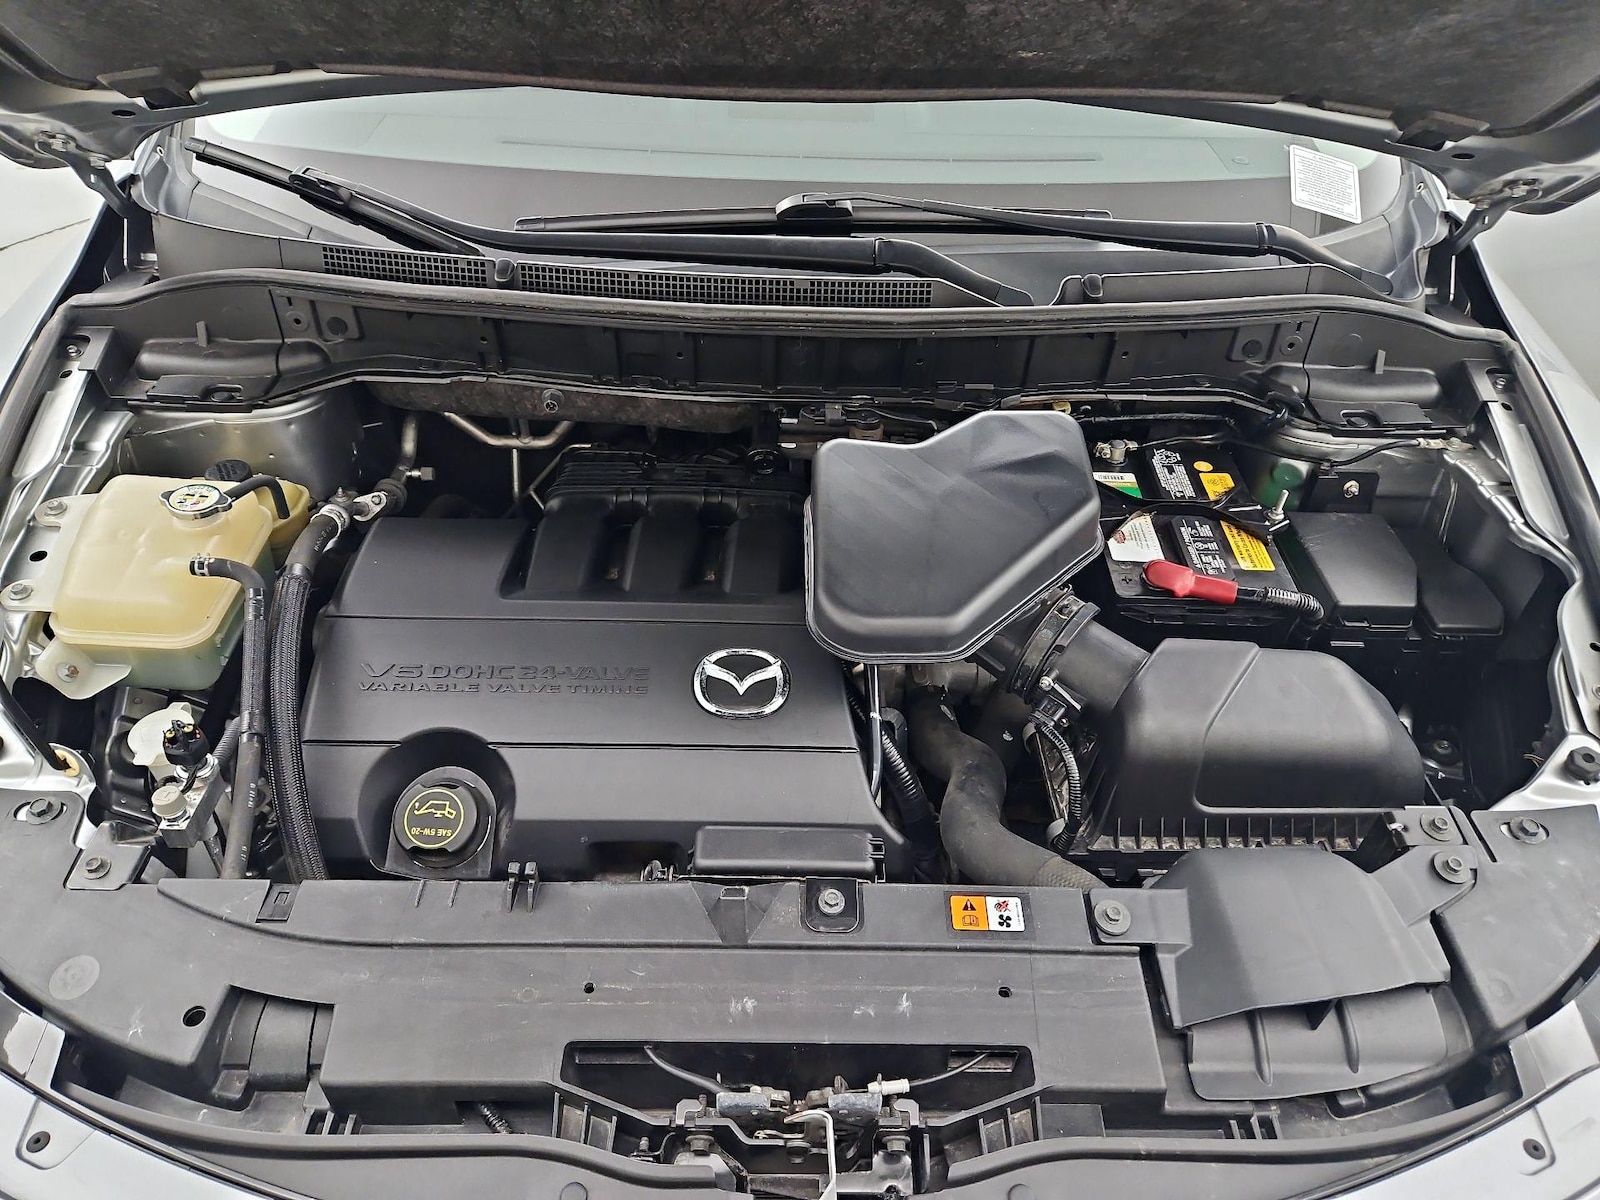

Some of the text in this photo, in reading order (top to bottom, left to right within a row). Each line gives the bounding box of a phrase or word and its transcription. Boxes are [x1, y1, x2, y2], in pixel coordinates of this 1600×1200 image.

[360, 662, 651, 681] V6 DOHC 24-VALVE
[359, 681, 650, 695] VARIABLE VALVE TIMING
[410, 826, 453, 838] SAE 5W-20
